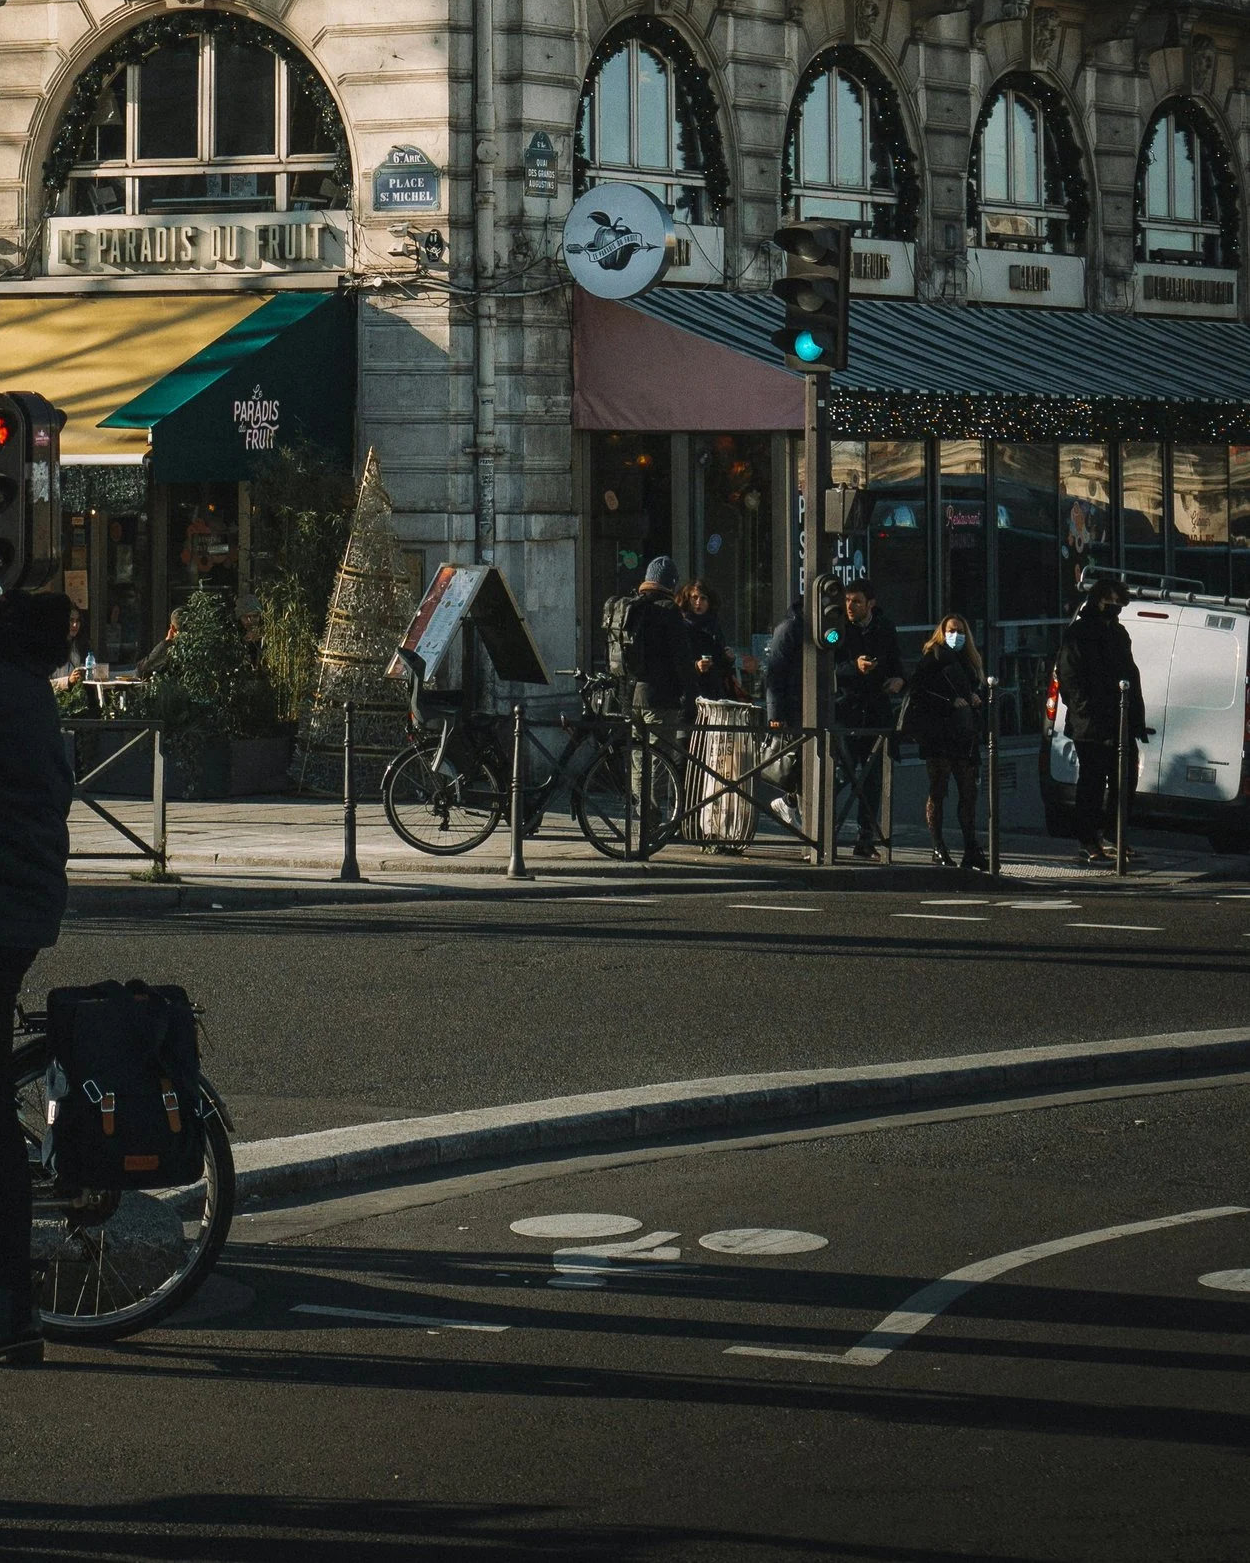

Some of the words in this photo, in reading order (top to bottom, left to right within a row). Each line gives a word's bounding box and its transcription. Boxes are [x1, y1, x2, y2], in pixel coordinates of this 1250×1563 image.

[536, 159, 548, 167] QUAI
[389, 178, 425, 189] PLACE
[392, 191, 433, 202] MICHEL
[58, 229, 85, 264] LE
[97, 226, 197, 263] PARADIS
[210, 225, 241, 261] DU
[254, 223, 327, 261] FRUIT
[861, 252, 891, 280] FRUITS
[252, 384, 263, 400] Le
[233, 400, 280, 423] PARADIS
[246, 423, 279, 451] FRUIT
